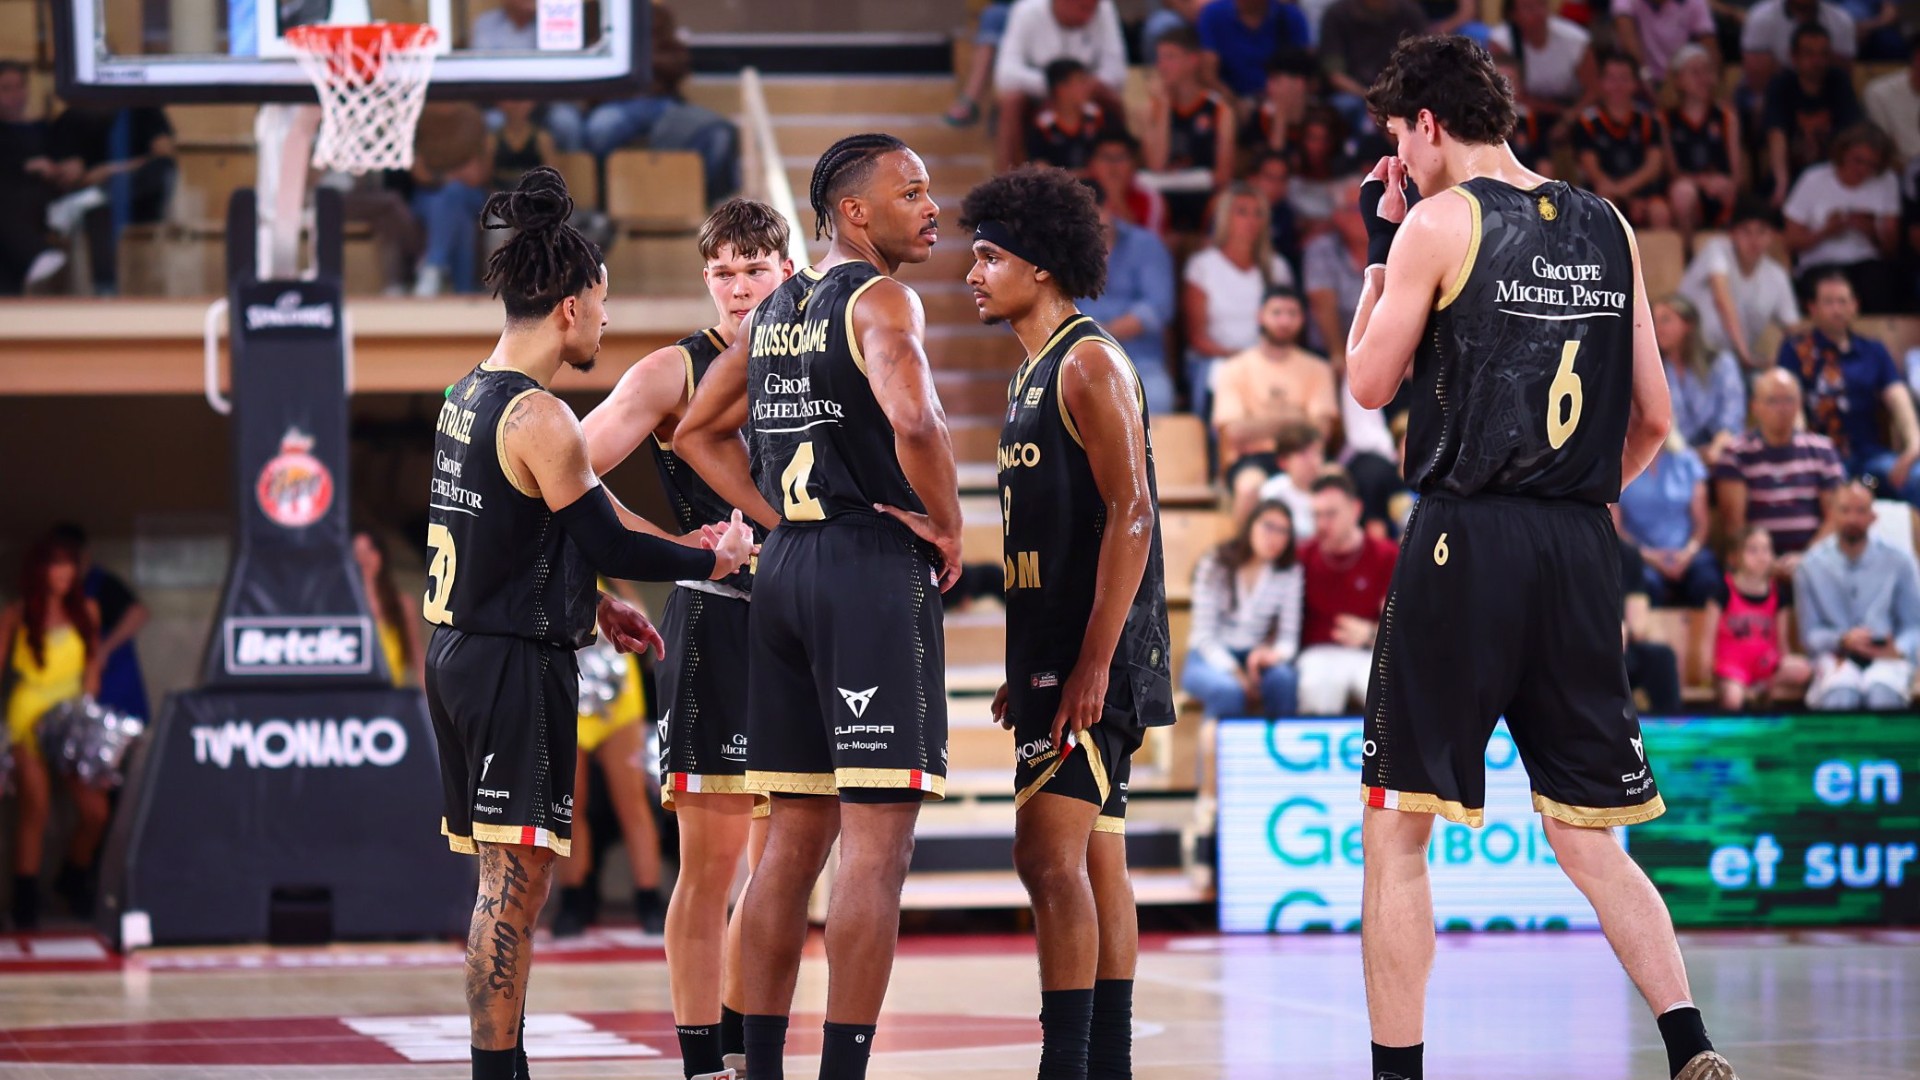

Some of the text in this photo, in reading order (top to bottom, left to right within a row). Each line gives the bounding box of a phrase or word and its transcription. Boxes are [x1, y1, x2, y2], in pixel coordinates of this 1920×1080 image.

[1532, 255, 1602, 281] GROUPE
[1494, 280, 1626, 310] MICHEL PASTOR
[1547, 340, 1583, 450] 6
[436, 401, 476, 445] STRAZEL
[781, 441, 826, 522] 4
[1433, 532, 1449, 566] 6
[237, 629, 359, 664] Betclic
[191, 716, 408, 769] TVMONACO
[1814, 760, 1901, 805] en
[1710, 833, 1916, 889] et sur
